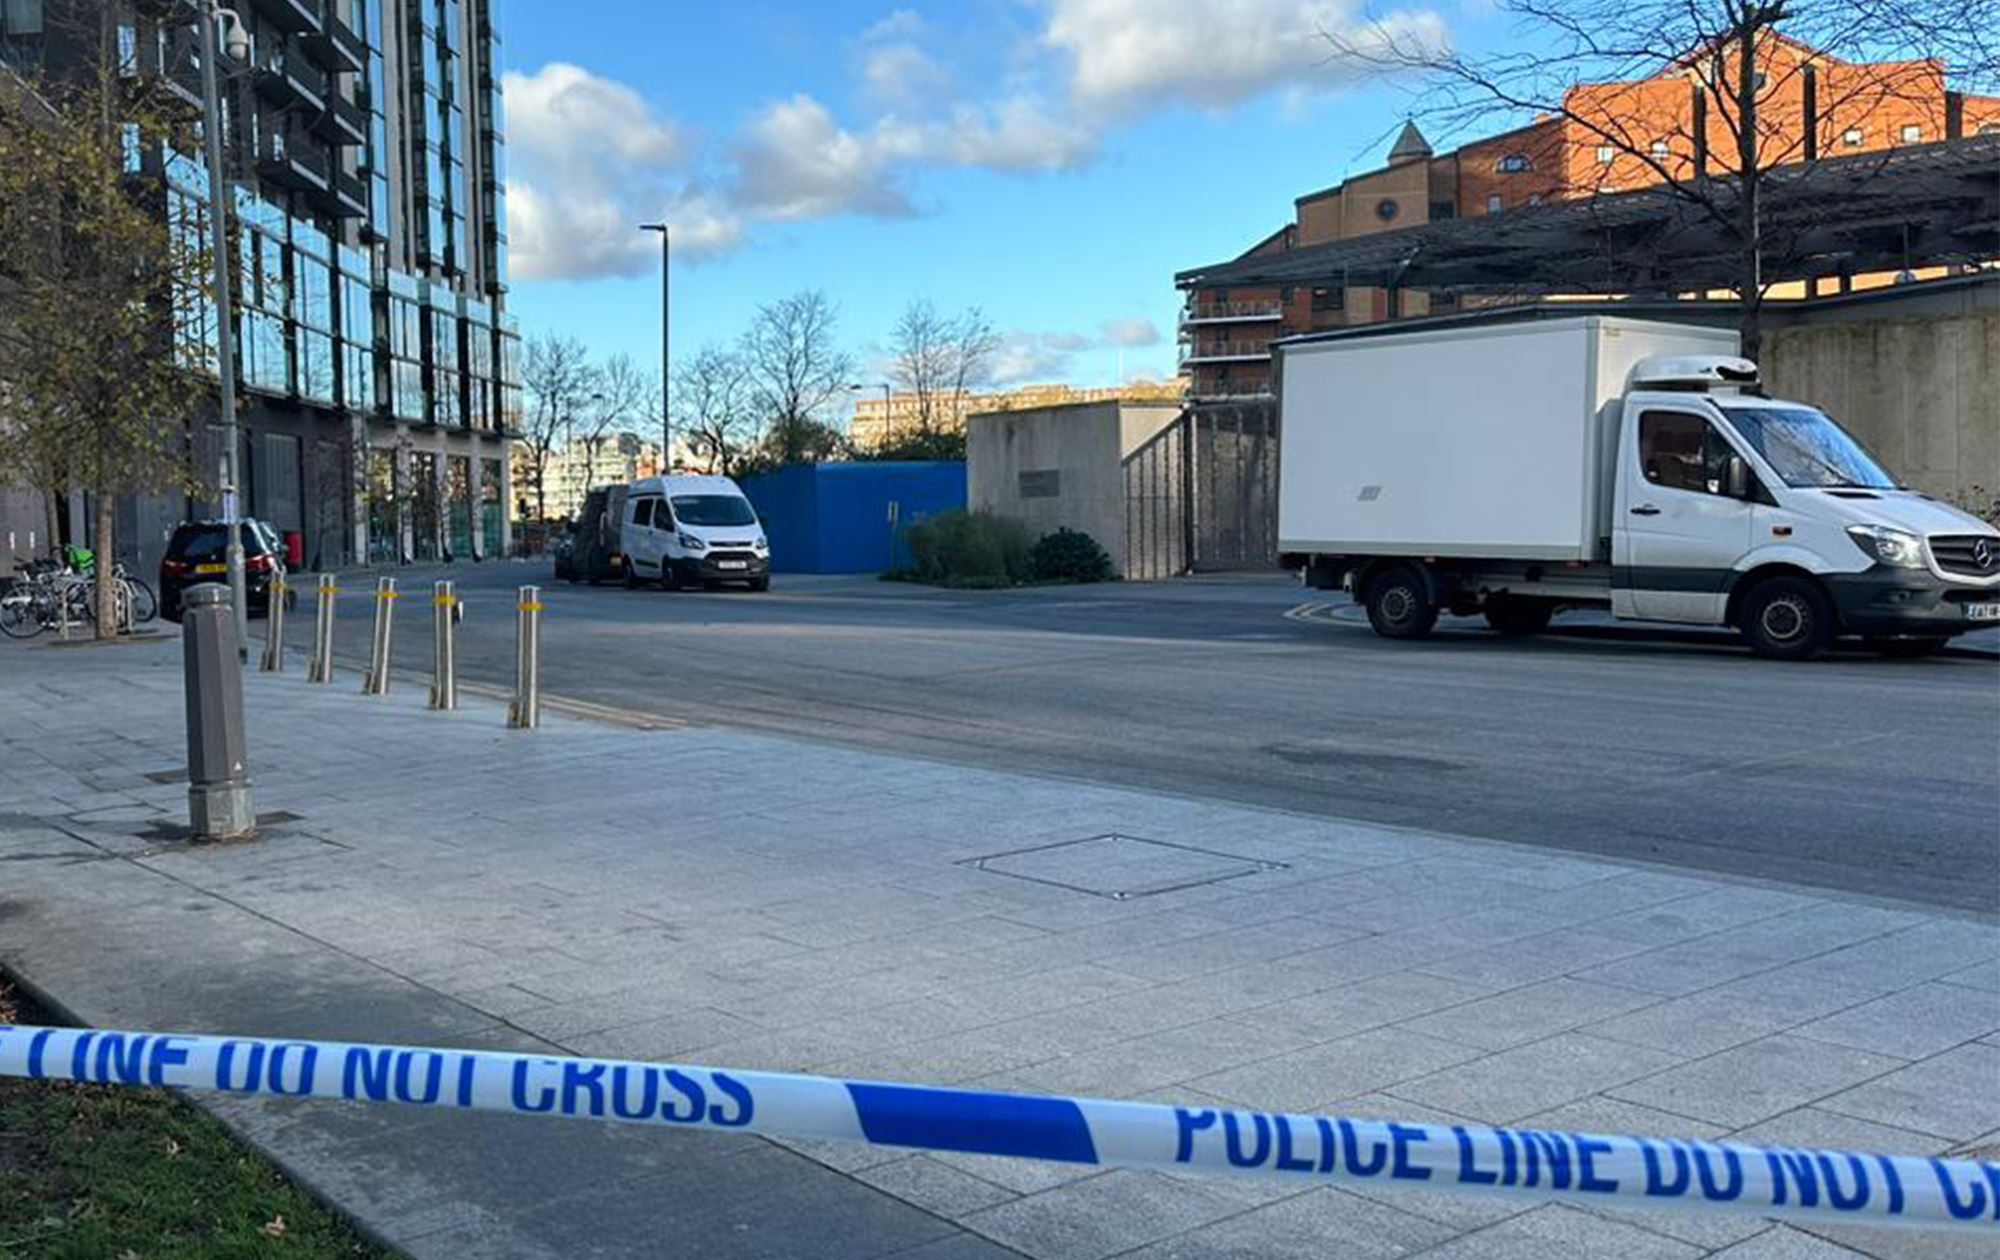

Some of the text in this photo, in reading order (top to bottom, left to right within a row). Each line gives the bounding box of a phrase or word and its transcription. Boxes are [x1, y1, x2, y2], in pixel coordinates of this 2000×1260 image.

[215, 1039, 317, 1095] DO
[511, 1059, 754, 1127] CROSS
[1174, 1107, 1433, 1181] POLICE
[1451, 1125, 1620, 1193] LINE
[1636, 1136, 1744, 1201] DO
[1764, 1151, 1905, 1215] NOT
